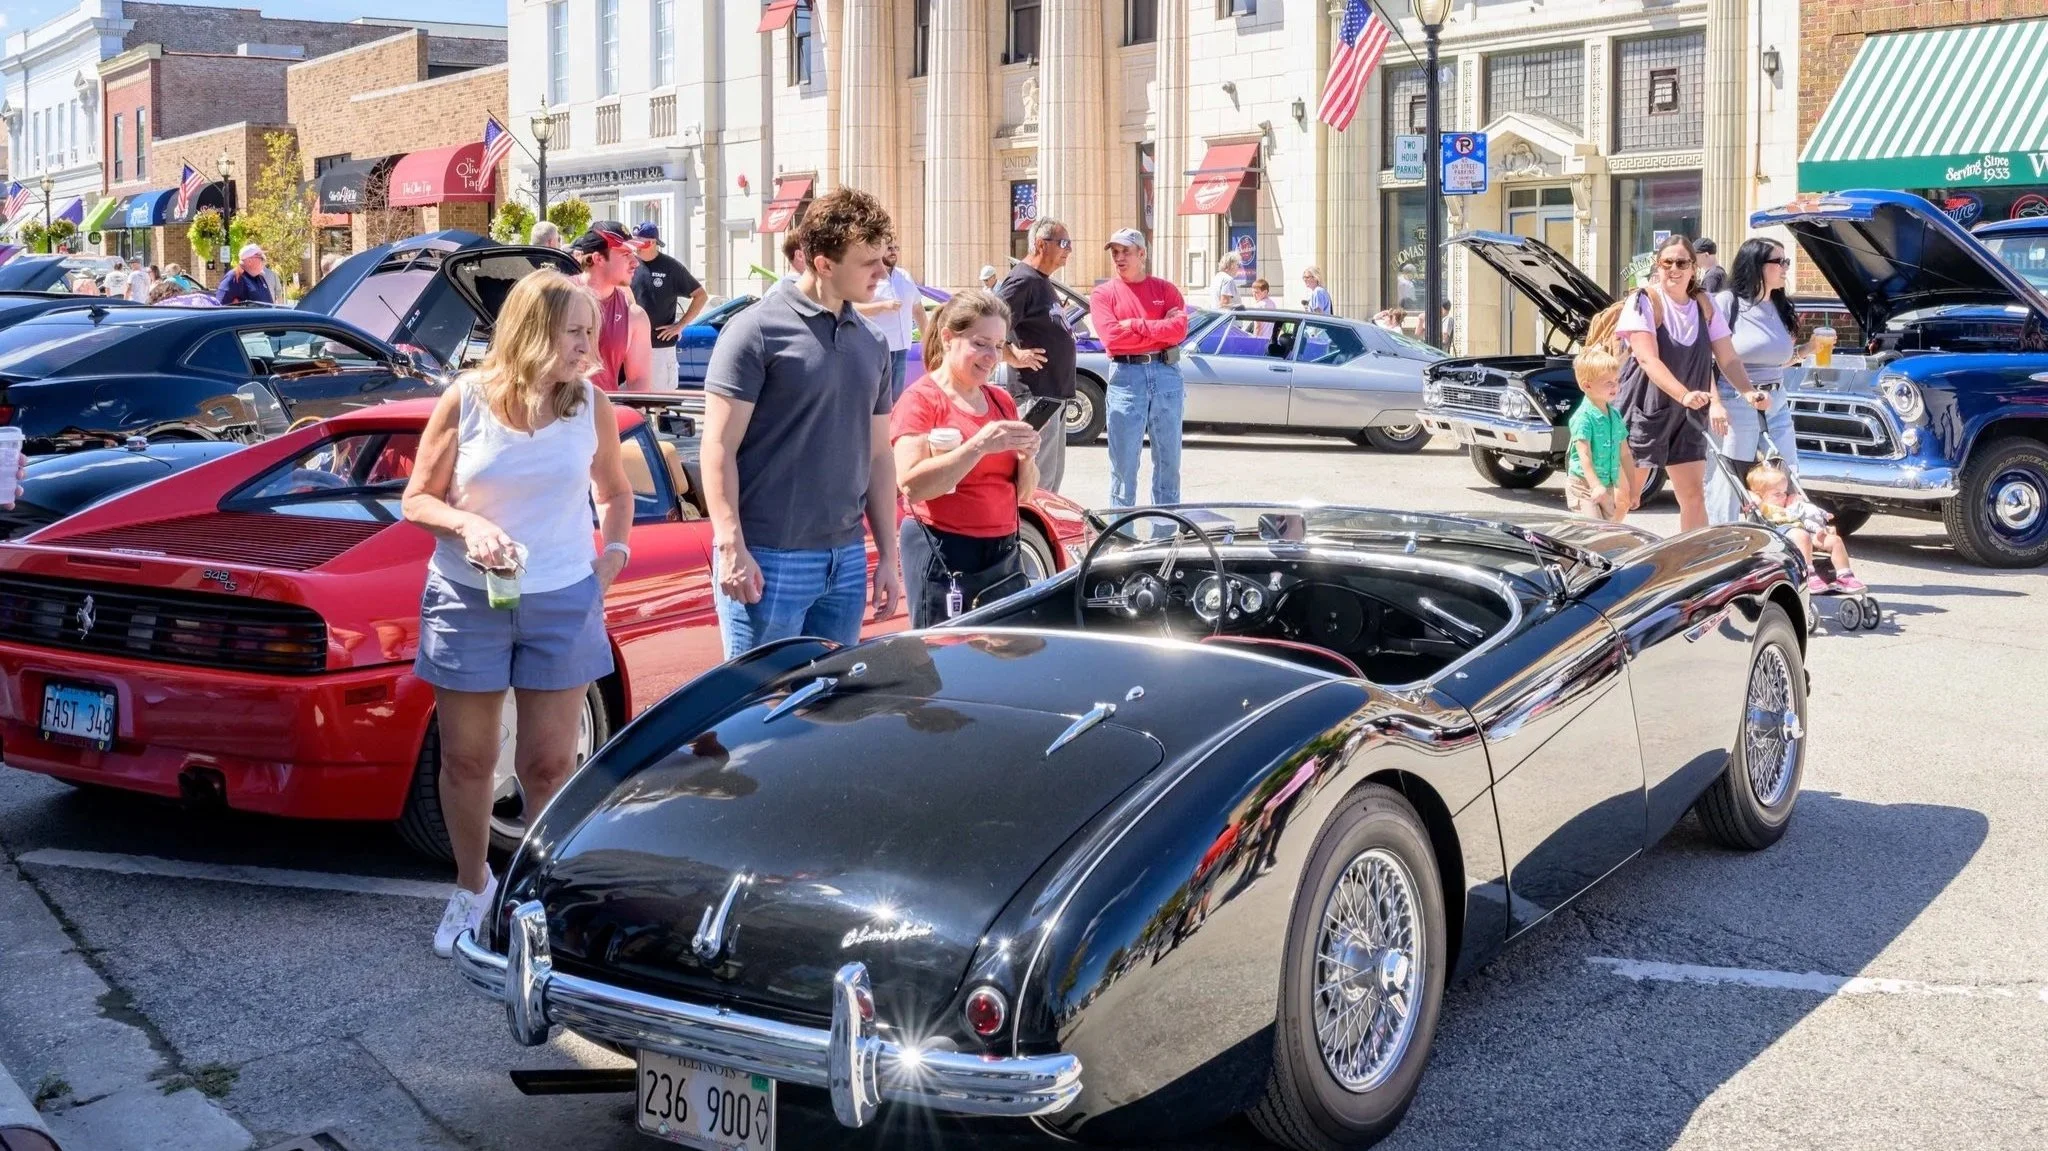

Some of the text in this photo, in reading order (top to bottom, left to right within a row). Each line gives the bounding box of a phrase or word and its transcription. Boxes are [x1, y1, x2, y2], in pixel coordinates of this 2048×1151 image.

[1403, 140, 1416, 150] TWO
[1003, 156, 1031, 168] UNITED
[1401, 153, 1418, 162] HOUR
[1396, 165, 1422, 175] PARKING
[1945, 155, 2009, 181] Serving Since
[1983, 168, 2010, 182] 1933
[203, 569, 229, 582] 348
[44, 696, 113, 736] FAST 348
[677, 1059, 736, 1079] ILLINOIS
[645, 1069, 687, 1122] 236
[707, 1086, 751, 1140] 900
